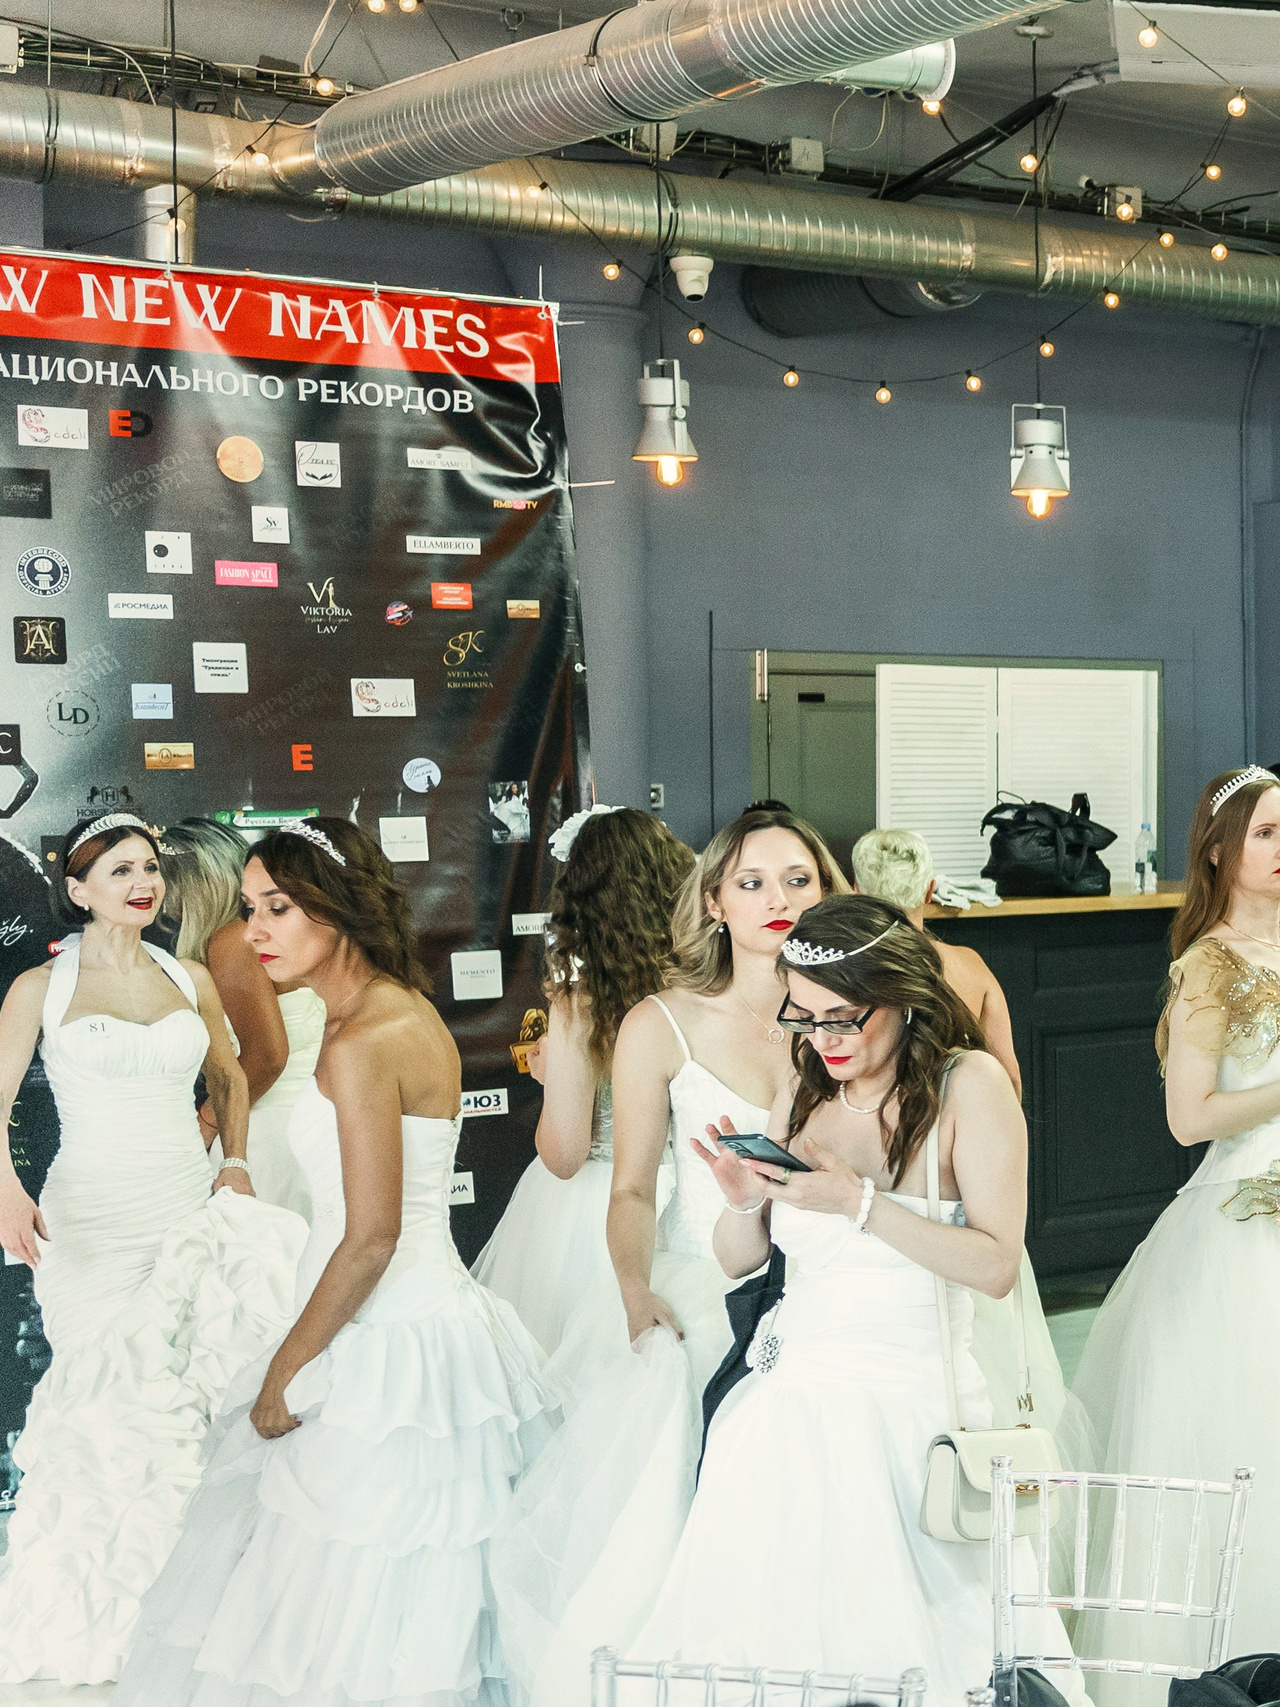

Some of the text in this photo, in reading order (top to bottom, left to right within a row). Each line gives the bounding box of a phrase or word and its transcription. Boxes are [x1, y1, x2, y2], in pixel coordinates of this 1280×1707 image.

[77, 272, 243, 332] NEW
[268, 291, 490, 358] NAMES
[297, 378, 475, 415] РЕКОРДОВ
[413, 540, 474, 550] ELLAMBERTO
[300, 605, 353, 617] VIKTORIA
[317, 624, 338, 634] LAV
[89, 1022, 106, 1033] 81
